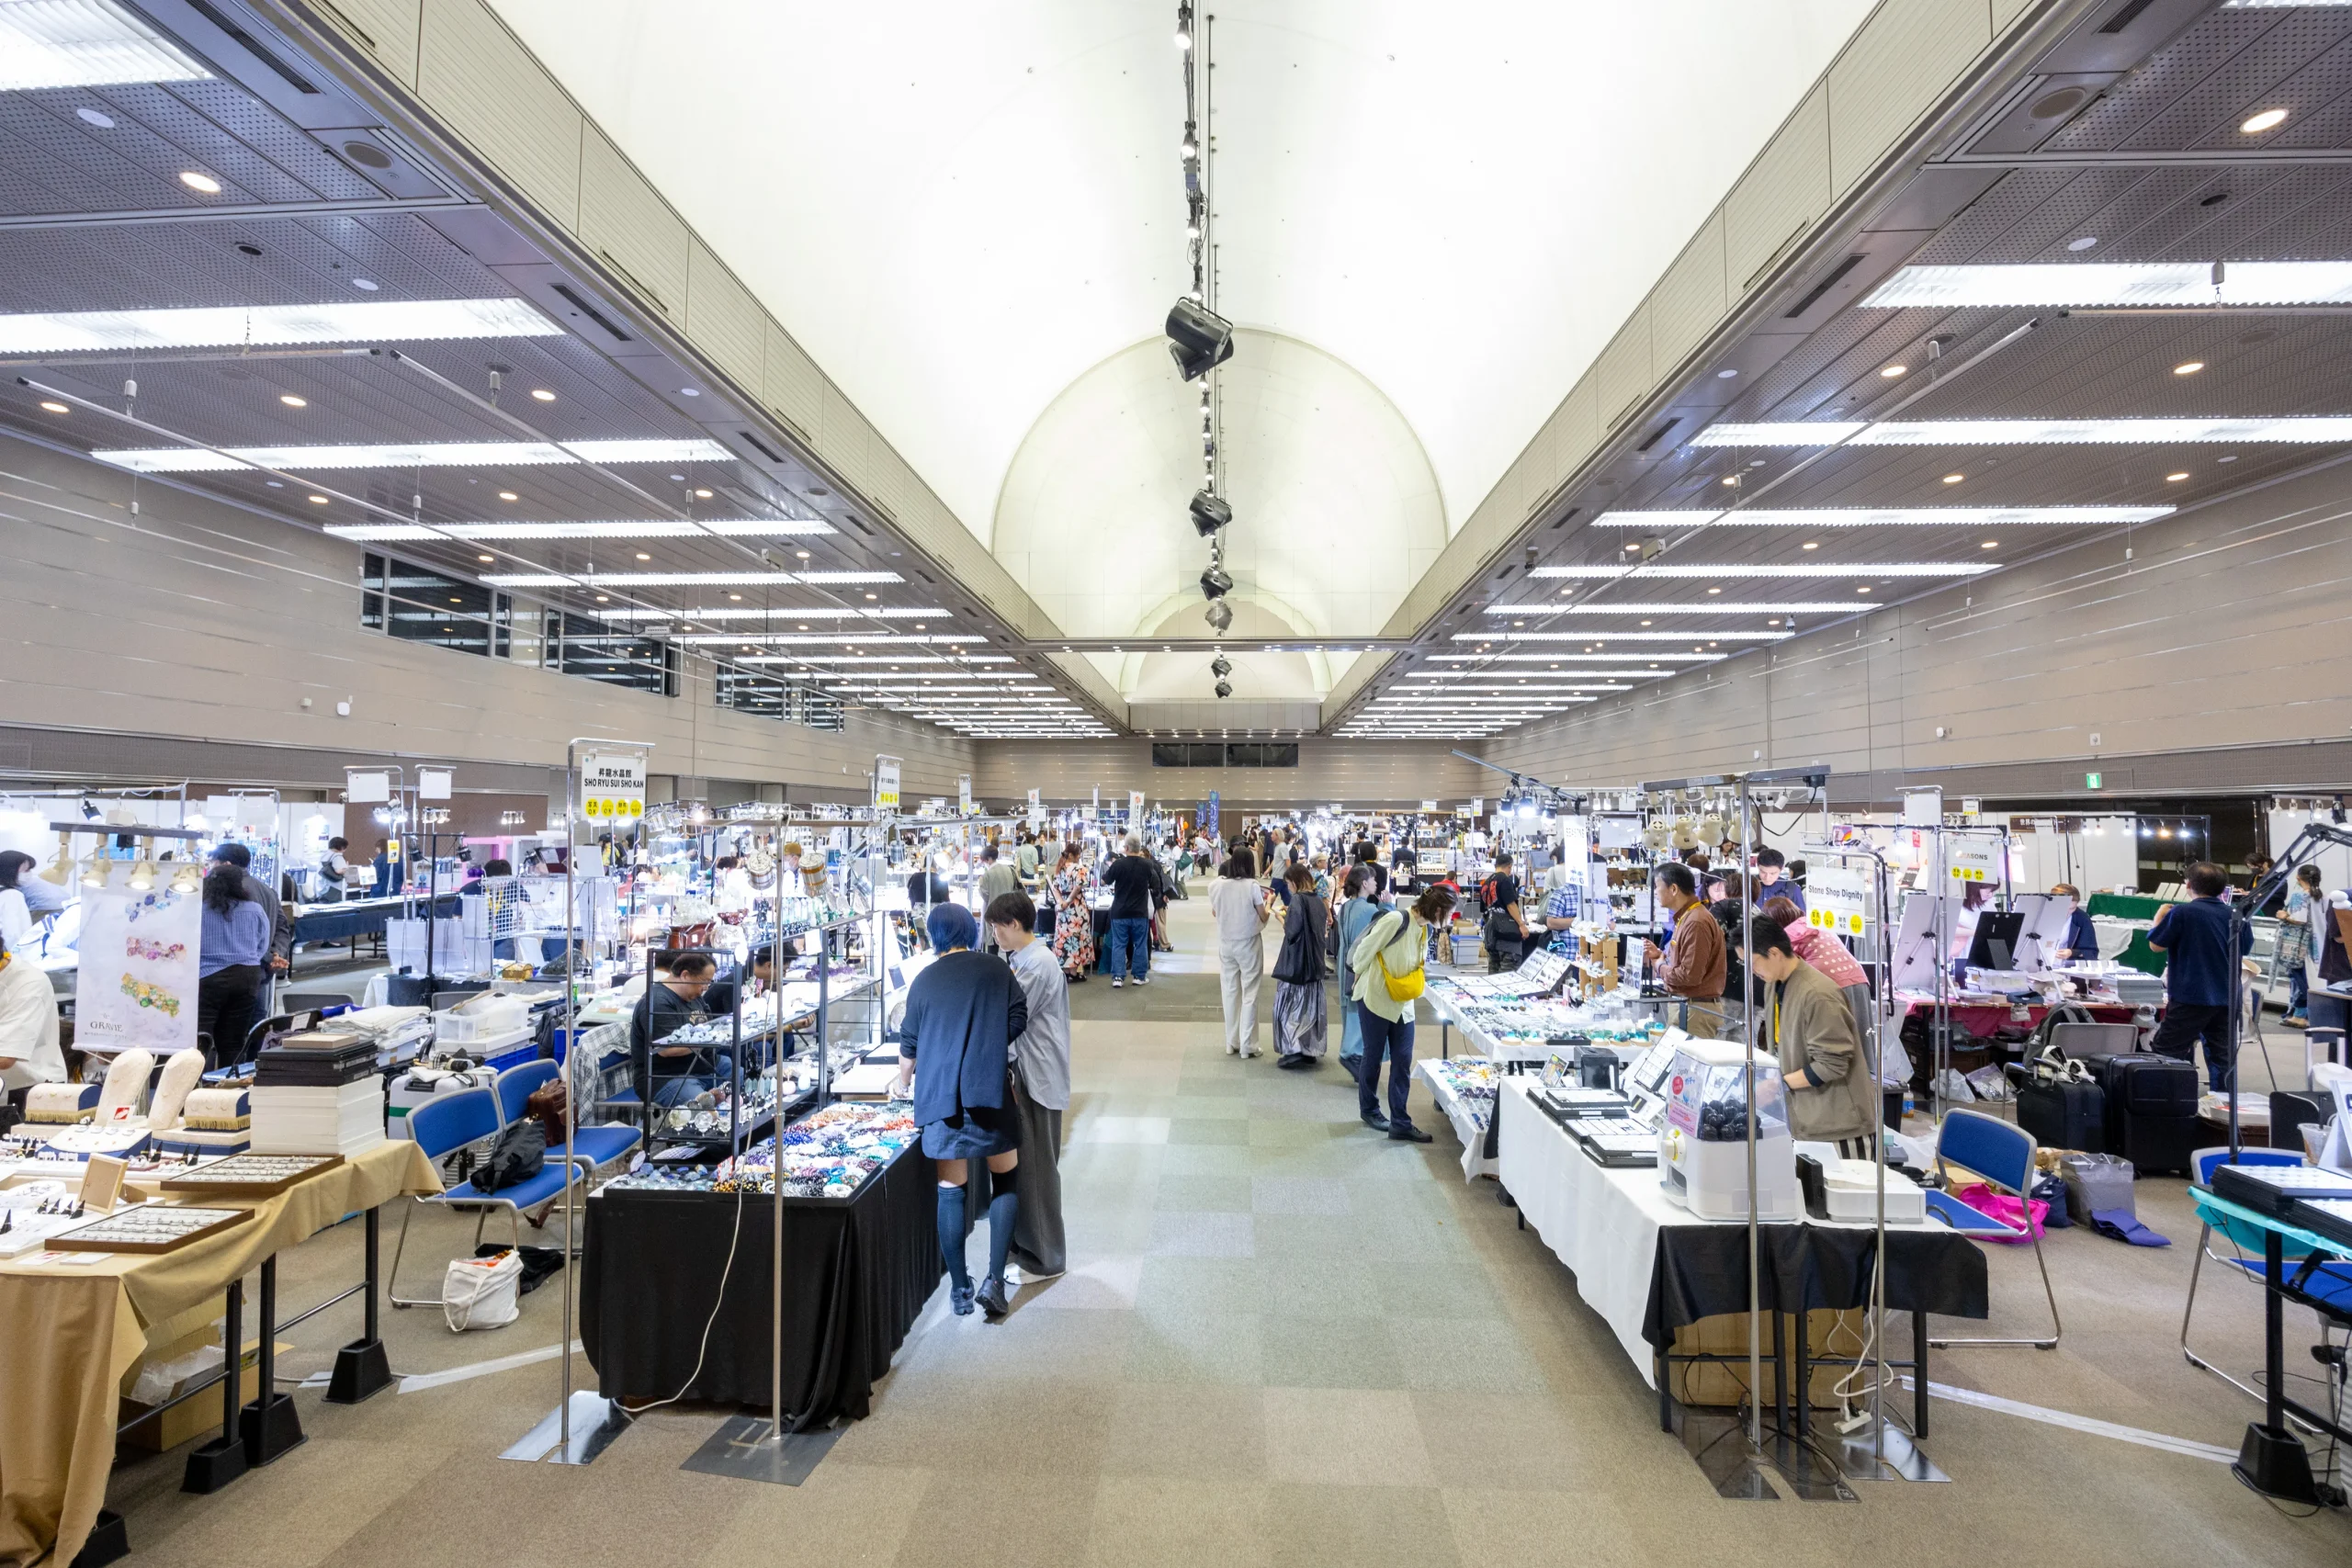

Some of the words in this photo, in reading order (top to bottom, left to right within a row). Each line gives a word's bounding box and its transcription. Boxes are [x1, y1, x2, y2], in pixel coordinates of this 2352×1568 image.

[599, 768, 632, 778] 昇龍水晶館
[584, 778, 597, 787] SHO
[598, 779, 610, 787] RYU
[611, 779, 620, 787] SUI
[621, 780, 632, 788] SHO
[633, 780, 644, 788] KAN
[1808, 885, 1825, 895] Stone
[1826, 886, 1840, 897] Shop
[1842, 889, 1863, 902] Dignity
